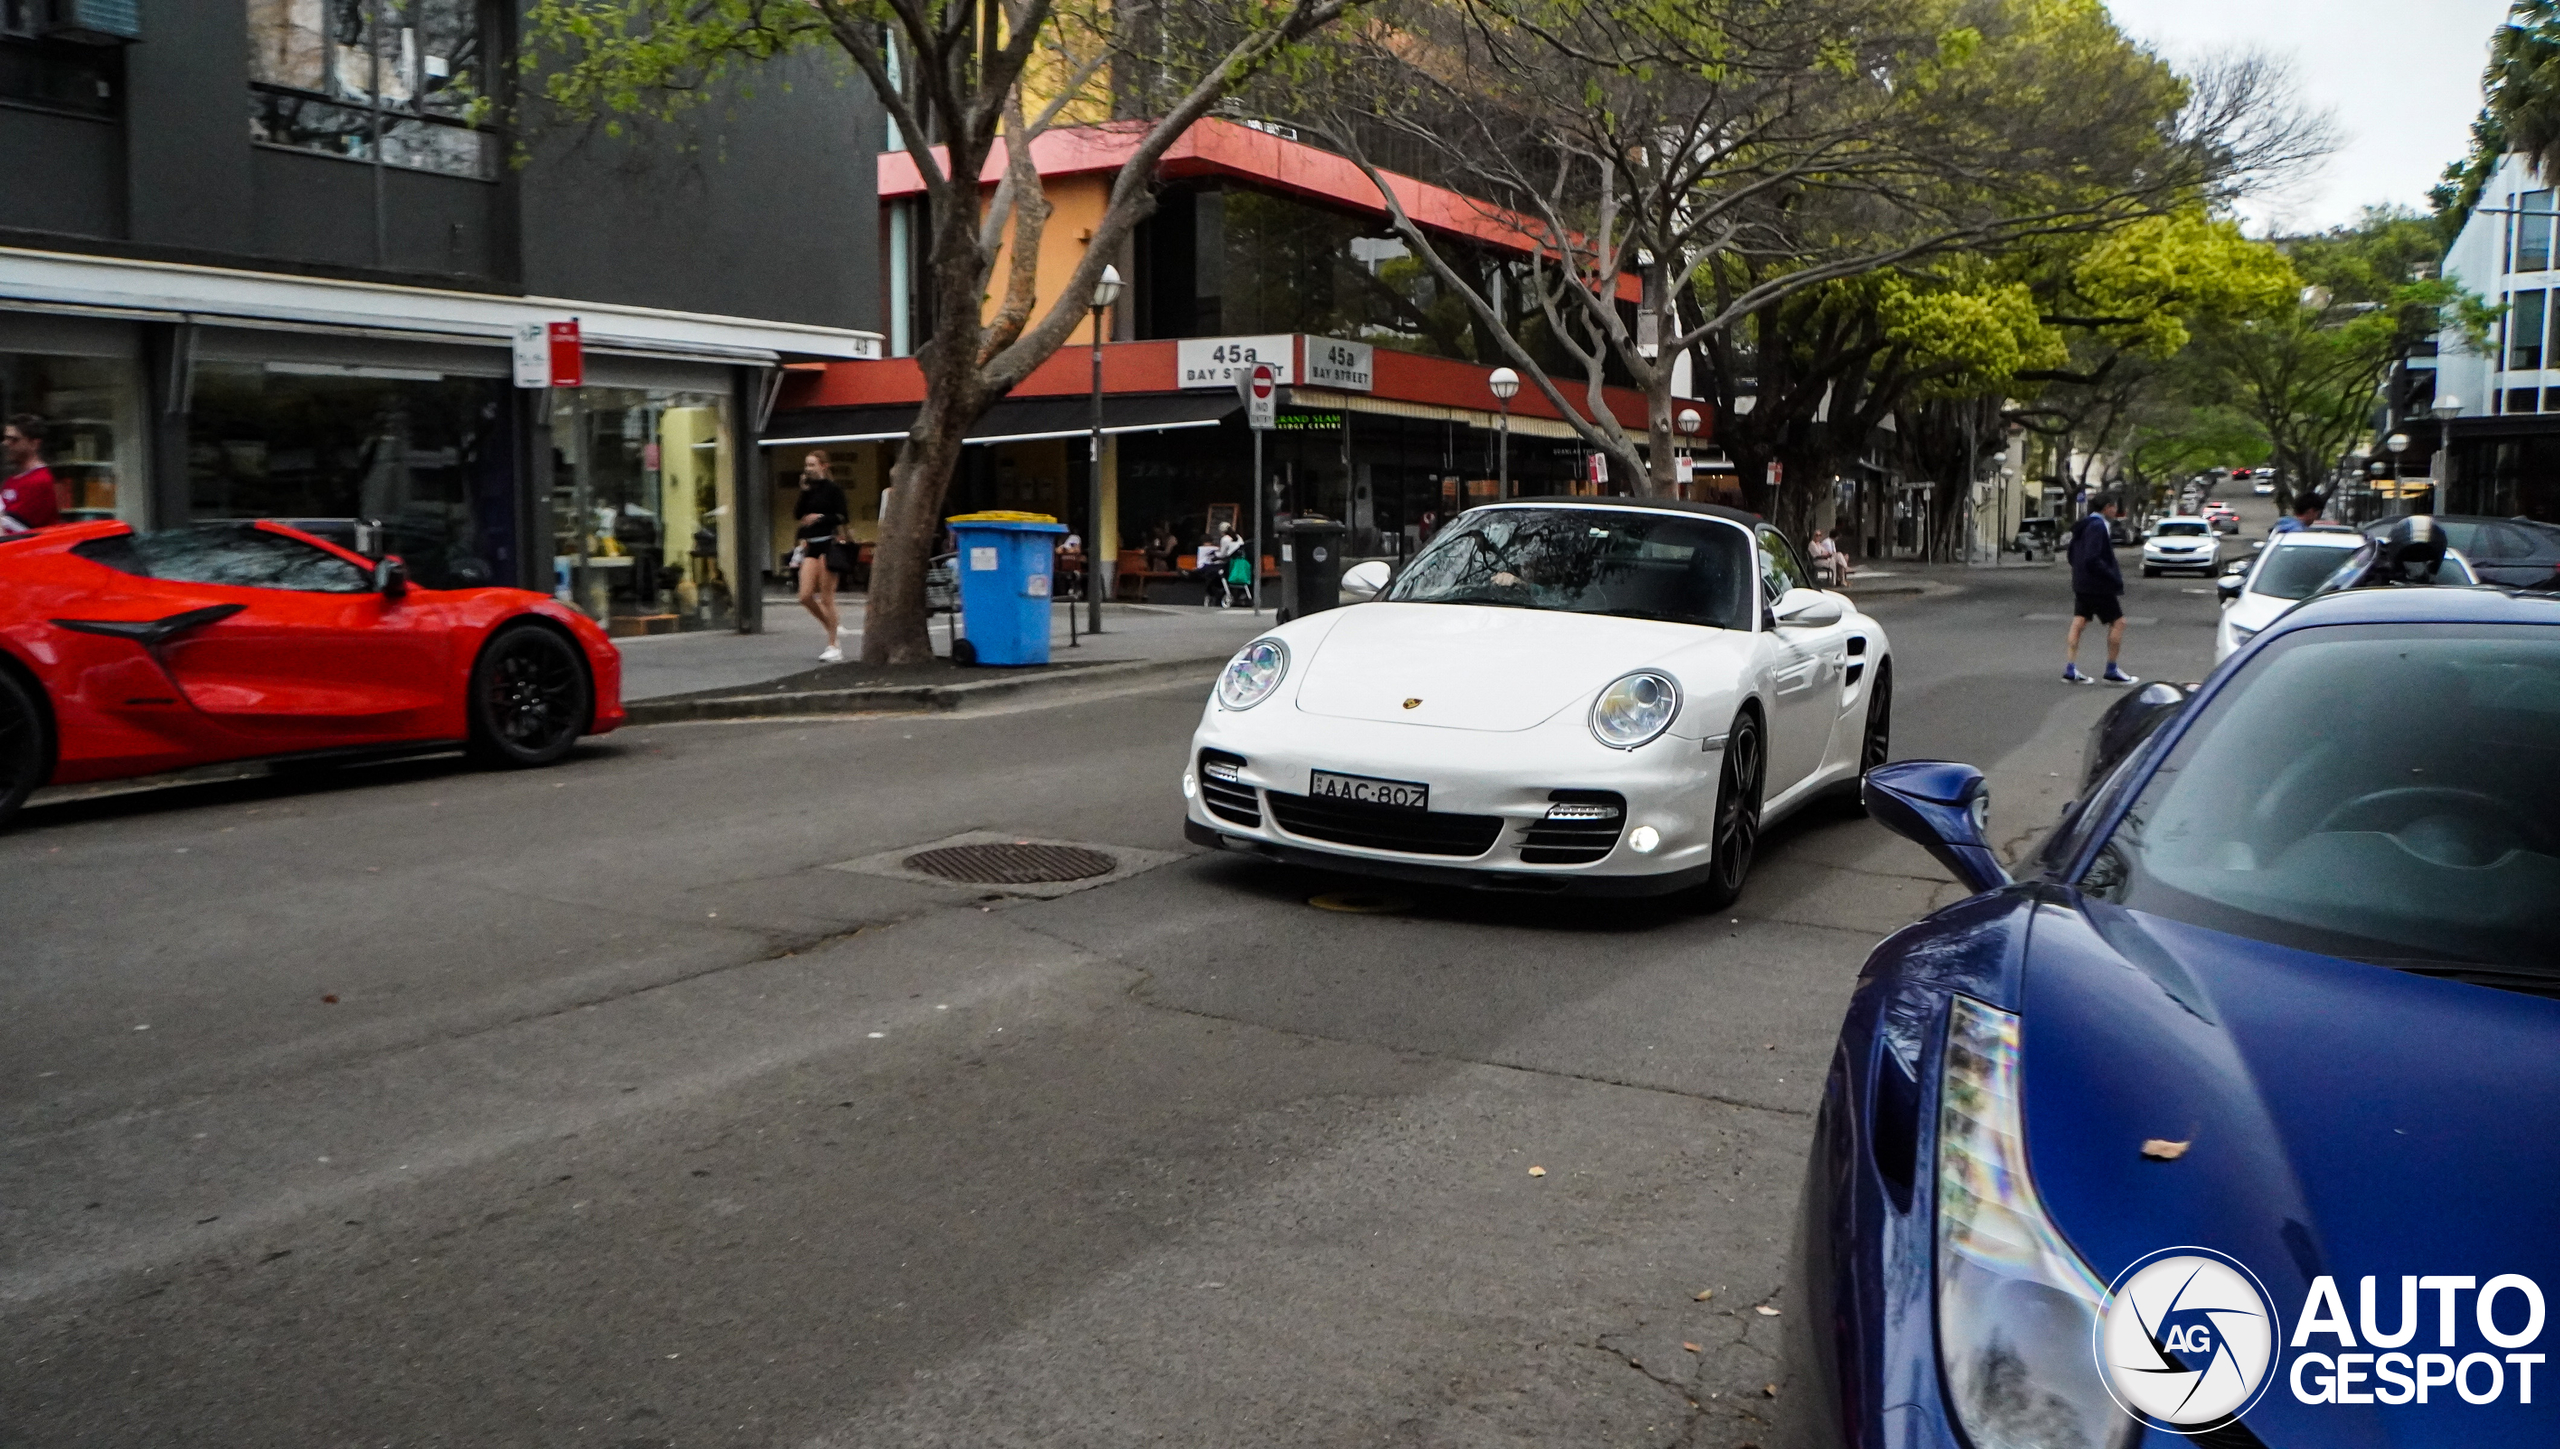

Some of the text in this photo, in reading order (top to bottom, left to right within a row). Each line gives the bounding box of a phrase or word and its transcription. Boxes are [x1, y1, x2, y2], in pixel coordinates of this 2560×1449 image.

[1213, 344, 1257, 364] 45a
[1328, 346, 1354, 367] 45a
[1186, 368, 1216, 380] BAY
[1313, 366, 1369, 384] BAY STREET
[1312, 414, 1341, 424] SLAM
